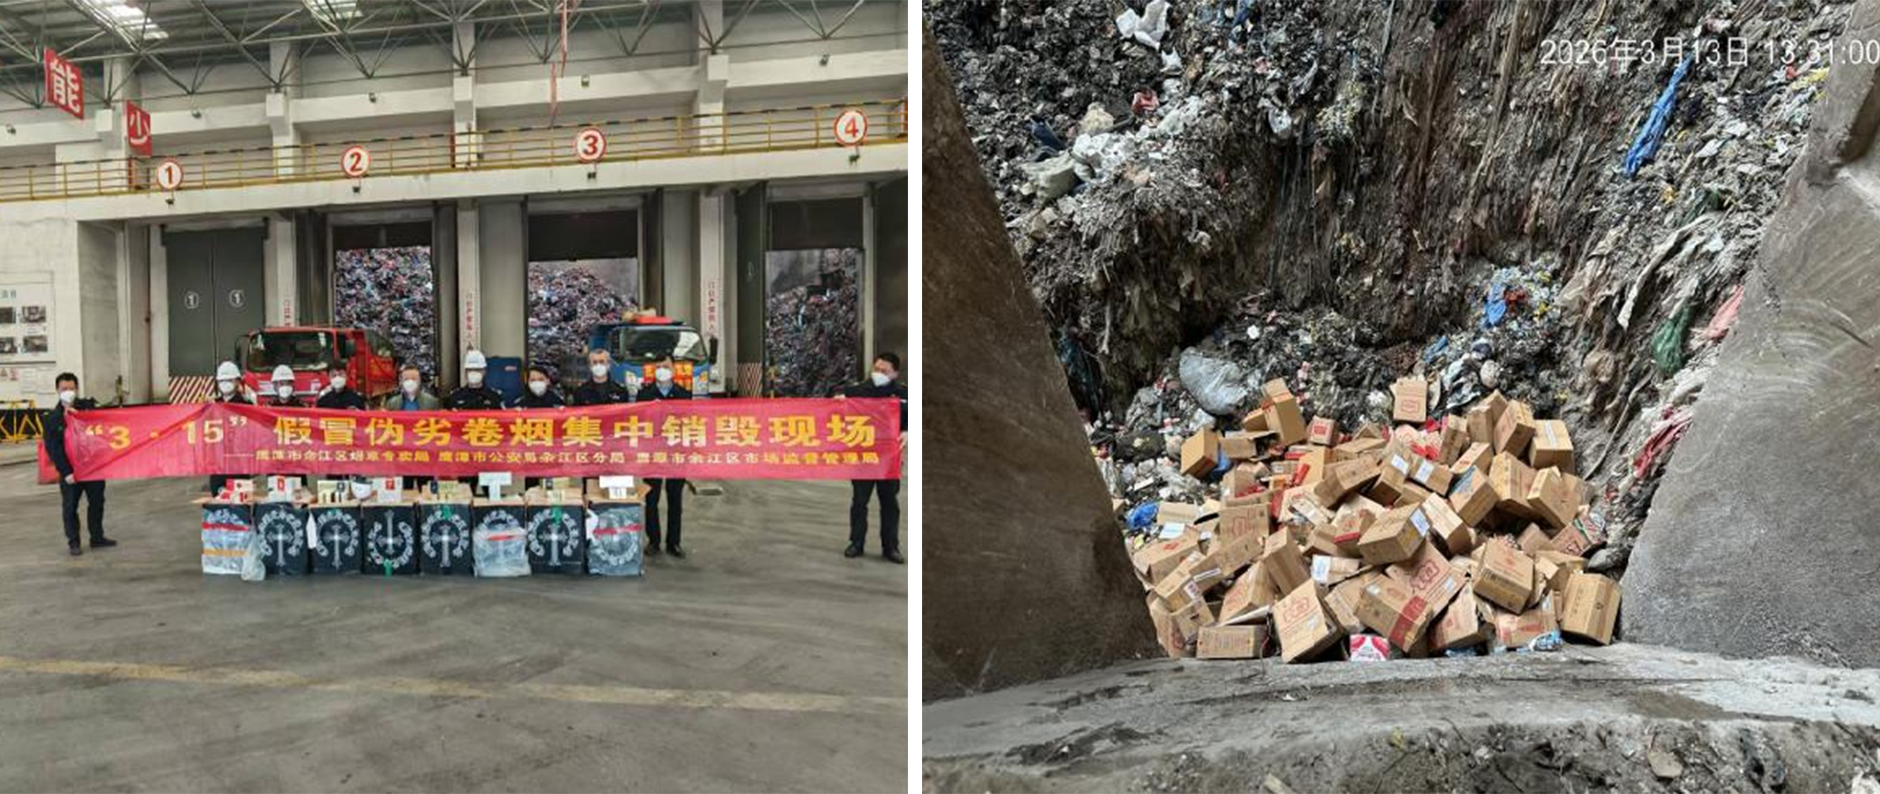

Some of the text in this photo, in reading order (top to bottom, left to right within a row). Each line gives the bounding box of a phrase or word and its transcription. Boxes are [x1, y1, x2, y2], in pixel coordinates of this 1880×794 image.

[49, 58, 80, 114] 能
[130, 110, 151, 145] 少
[273, 415, 876, 447] 假冒伪劣卷烟集中销毁现场
